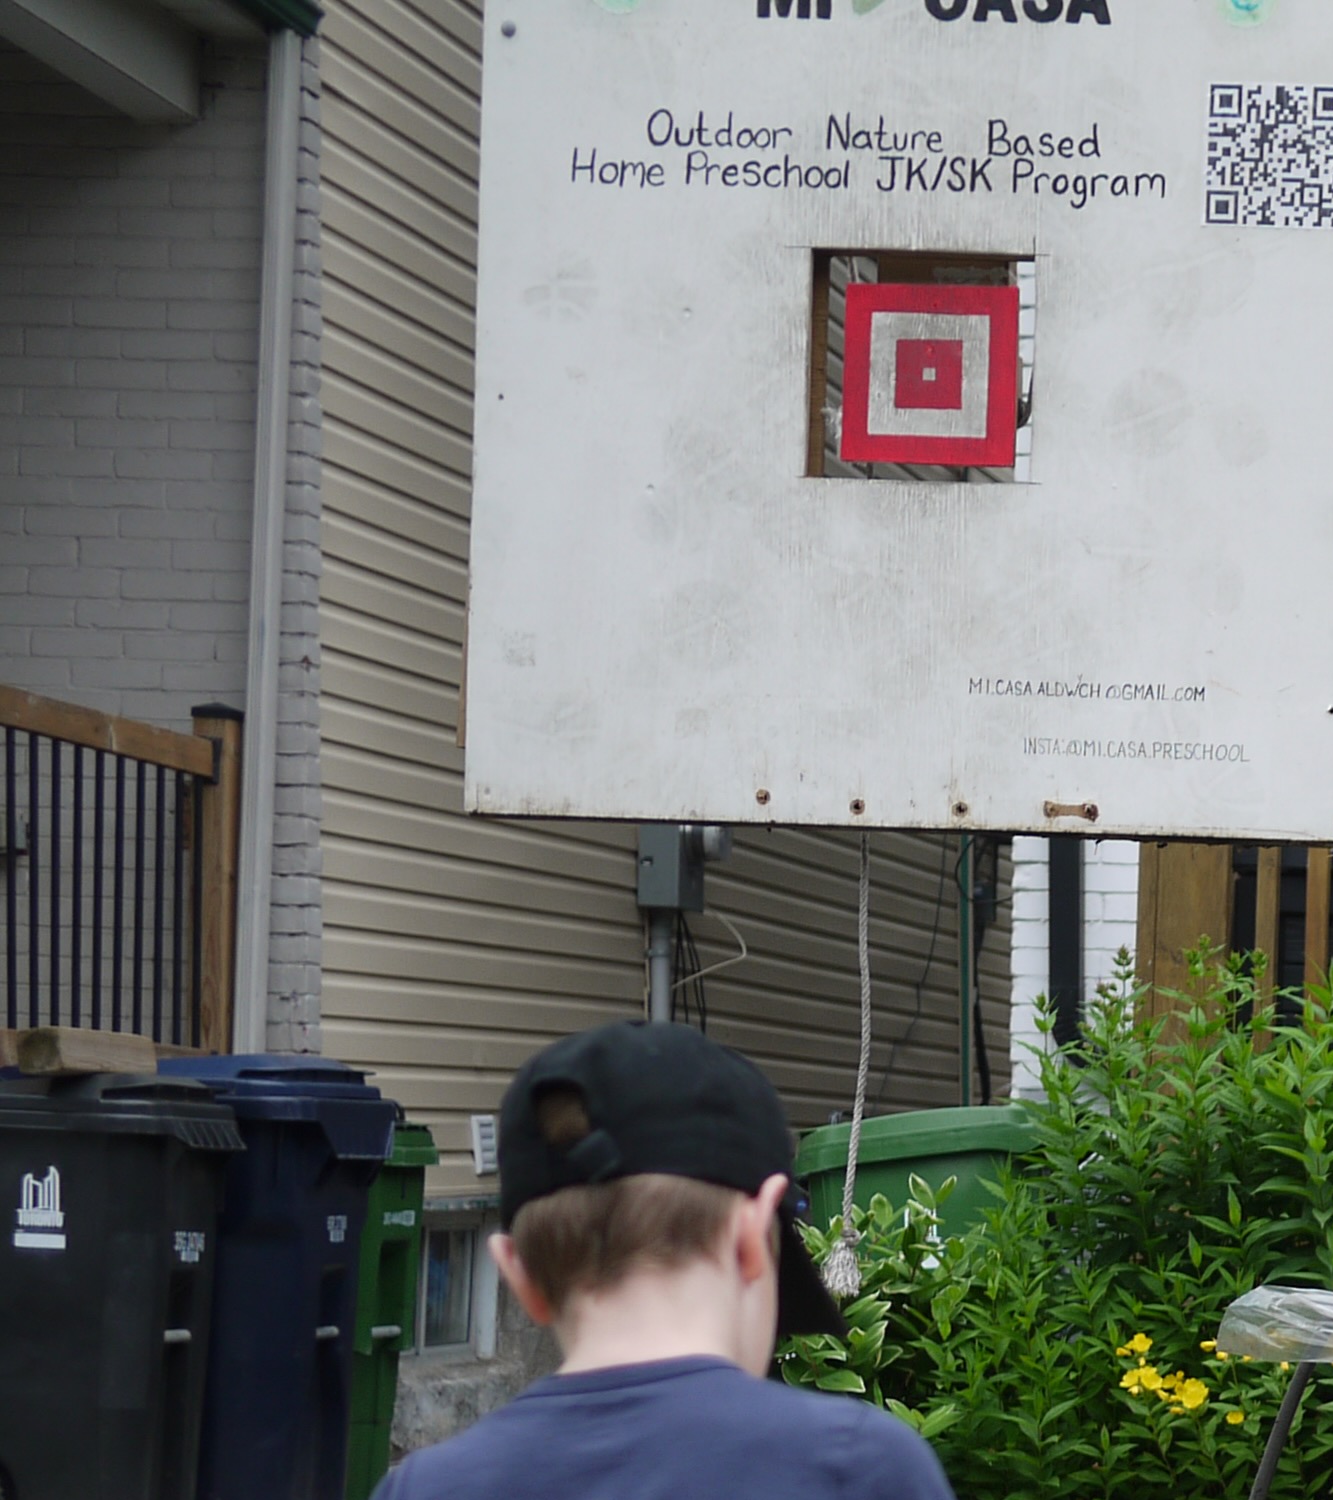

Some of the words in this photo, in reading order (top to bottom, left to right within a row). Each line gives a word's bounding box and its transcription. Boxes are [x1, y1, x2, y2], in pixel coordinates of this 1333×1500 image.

[646, 108, 793, 150] Outdoor
[826, 111, 944, 152] Nature
[988, 119, 1101, 158] Based
[571, 147, 666, 189] Home
[685, 149, 850, 190] Preschool
[876, 155, 993, 193] JK/SK
[1012, 157, 1166, 209] Program
